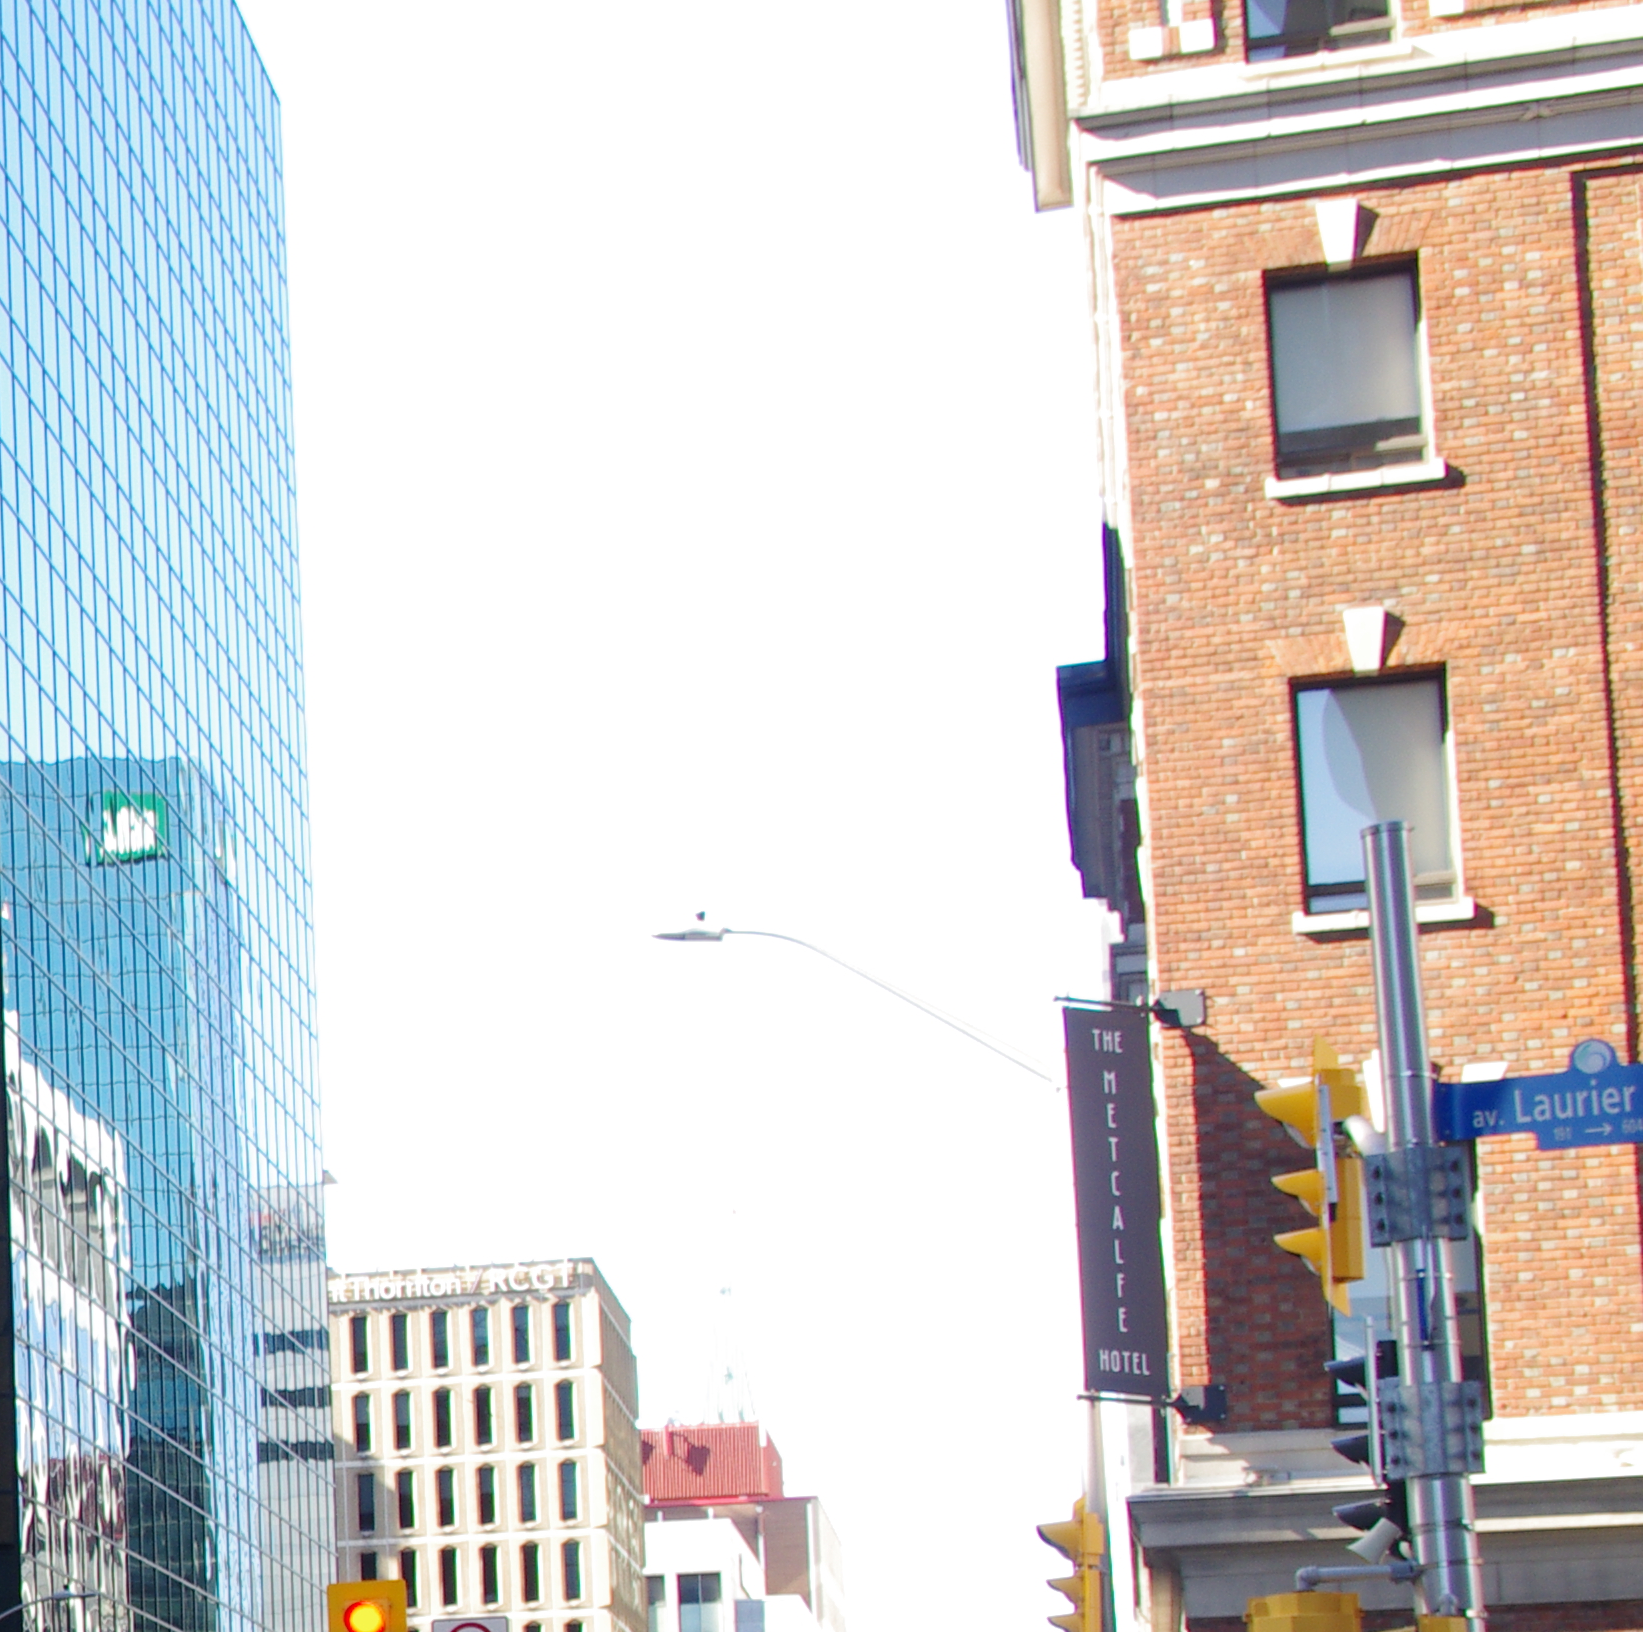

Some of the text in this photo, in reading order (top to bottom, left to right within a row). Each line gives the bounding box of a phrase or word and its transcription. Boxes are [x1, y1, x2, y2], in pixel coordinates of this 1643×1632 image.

[1092, 1028, 1123, 1054] THE
[1472, 1078, 1636, 1129] av. Laurier
[1102, 1070, 1129, 1334] METCALFE
[350, 1273, 461, 1301] Thornton
[488, 1263, 574, 1293] RCGT
[1099, 1347, 1151, 1377] HOTEL
